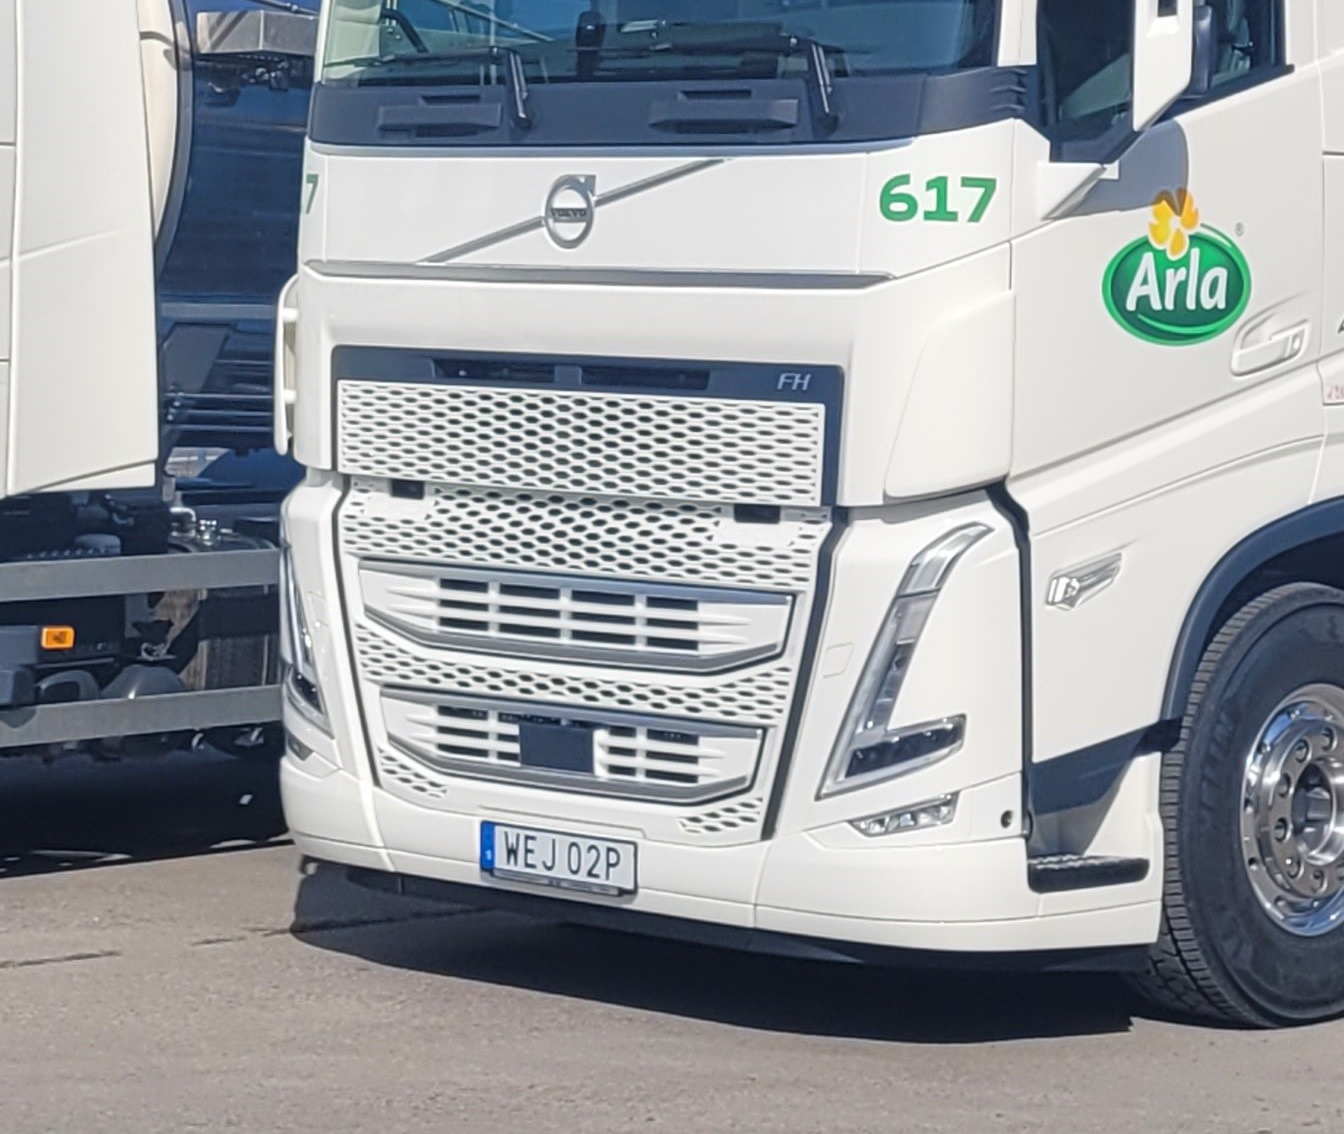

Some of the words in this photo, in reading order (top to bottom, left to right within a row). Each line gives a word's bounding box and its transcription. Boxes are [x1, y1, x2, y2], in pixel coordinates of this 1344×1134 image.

[879, 173, 998, 223] 617
[1125, 246, 1228, 312] Arla
[776, 372, 812, 391] FH
[504, 830, 556, 872] WEJ
[567, 841, 622, 881] 02P
